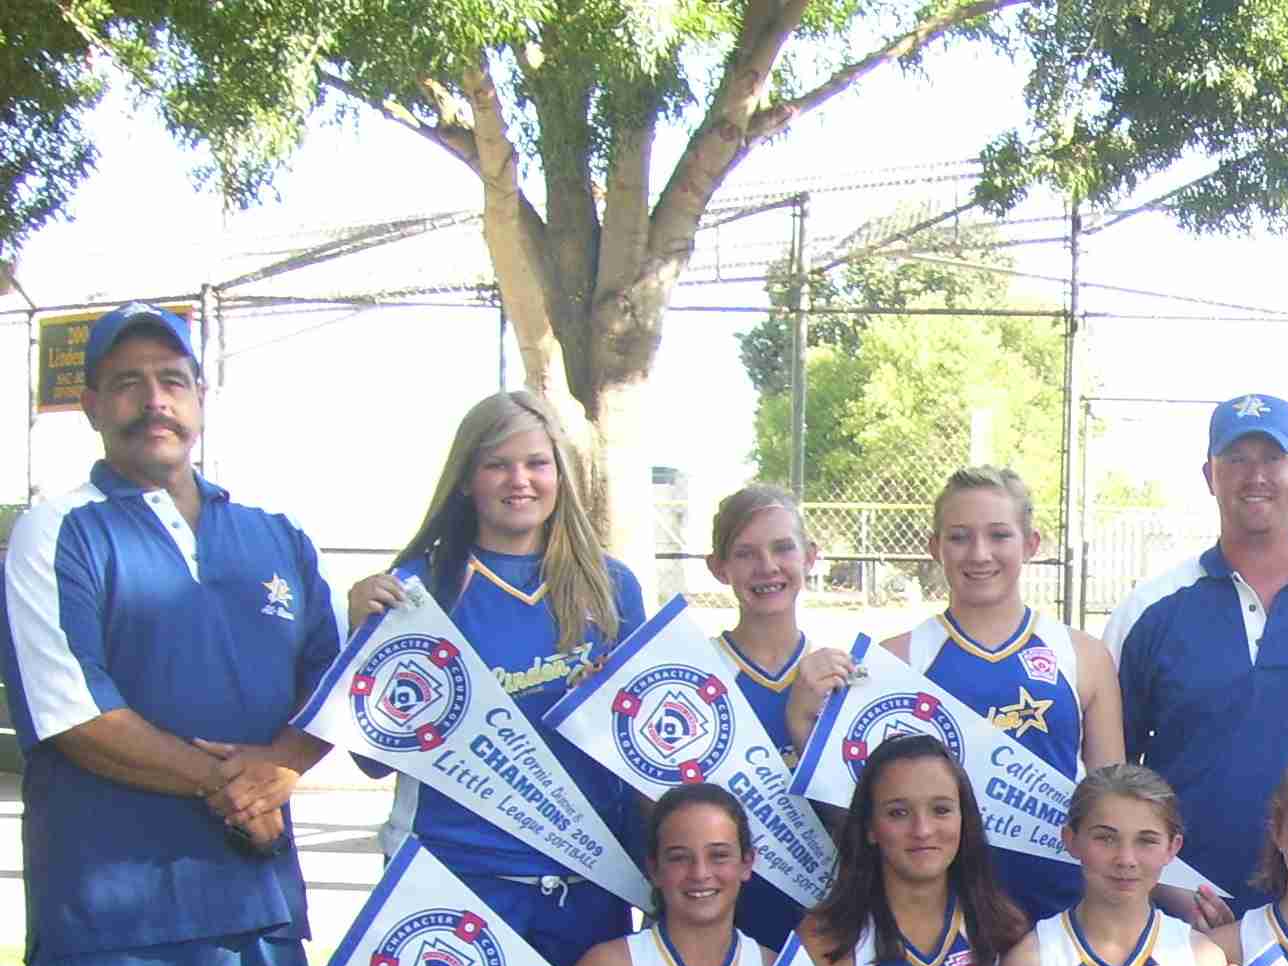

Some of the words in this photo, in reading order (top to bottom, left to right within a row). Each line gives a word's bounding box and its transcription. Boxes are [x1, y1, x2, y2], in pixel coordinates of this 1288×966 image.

[632, 668, 699, 693] CHARACTER
[704, 704, 730, 767] COURAGE
[851, 697, 910, 738] CHARACTER
[483, 706, 554, 788] California
[619, 731, 665, 778] LOYALTY
[430, 748, 494, 800] Little
[496, 794, 545, 835] League
[543, 830, 598, 869] SOFTBALL
[468, 732, 572, 832] CHAMPIONS
[569, 827, 604, 857] 2009
[724, 768, 820, 874] CHAMPIONS
[985, 775, 1067, 828] CHAMP
[385, 914, 453, 952] CHARACTER
